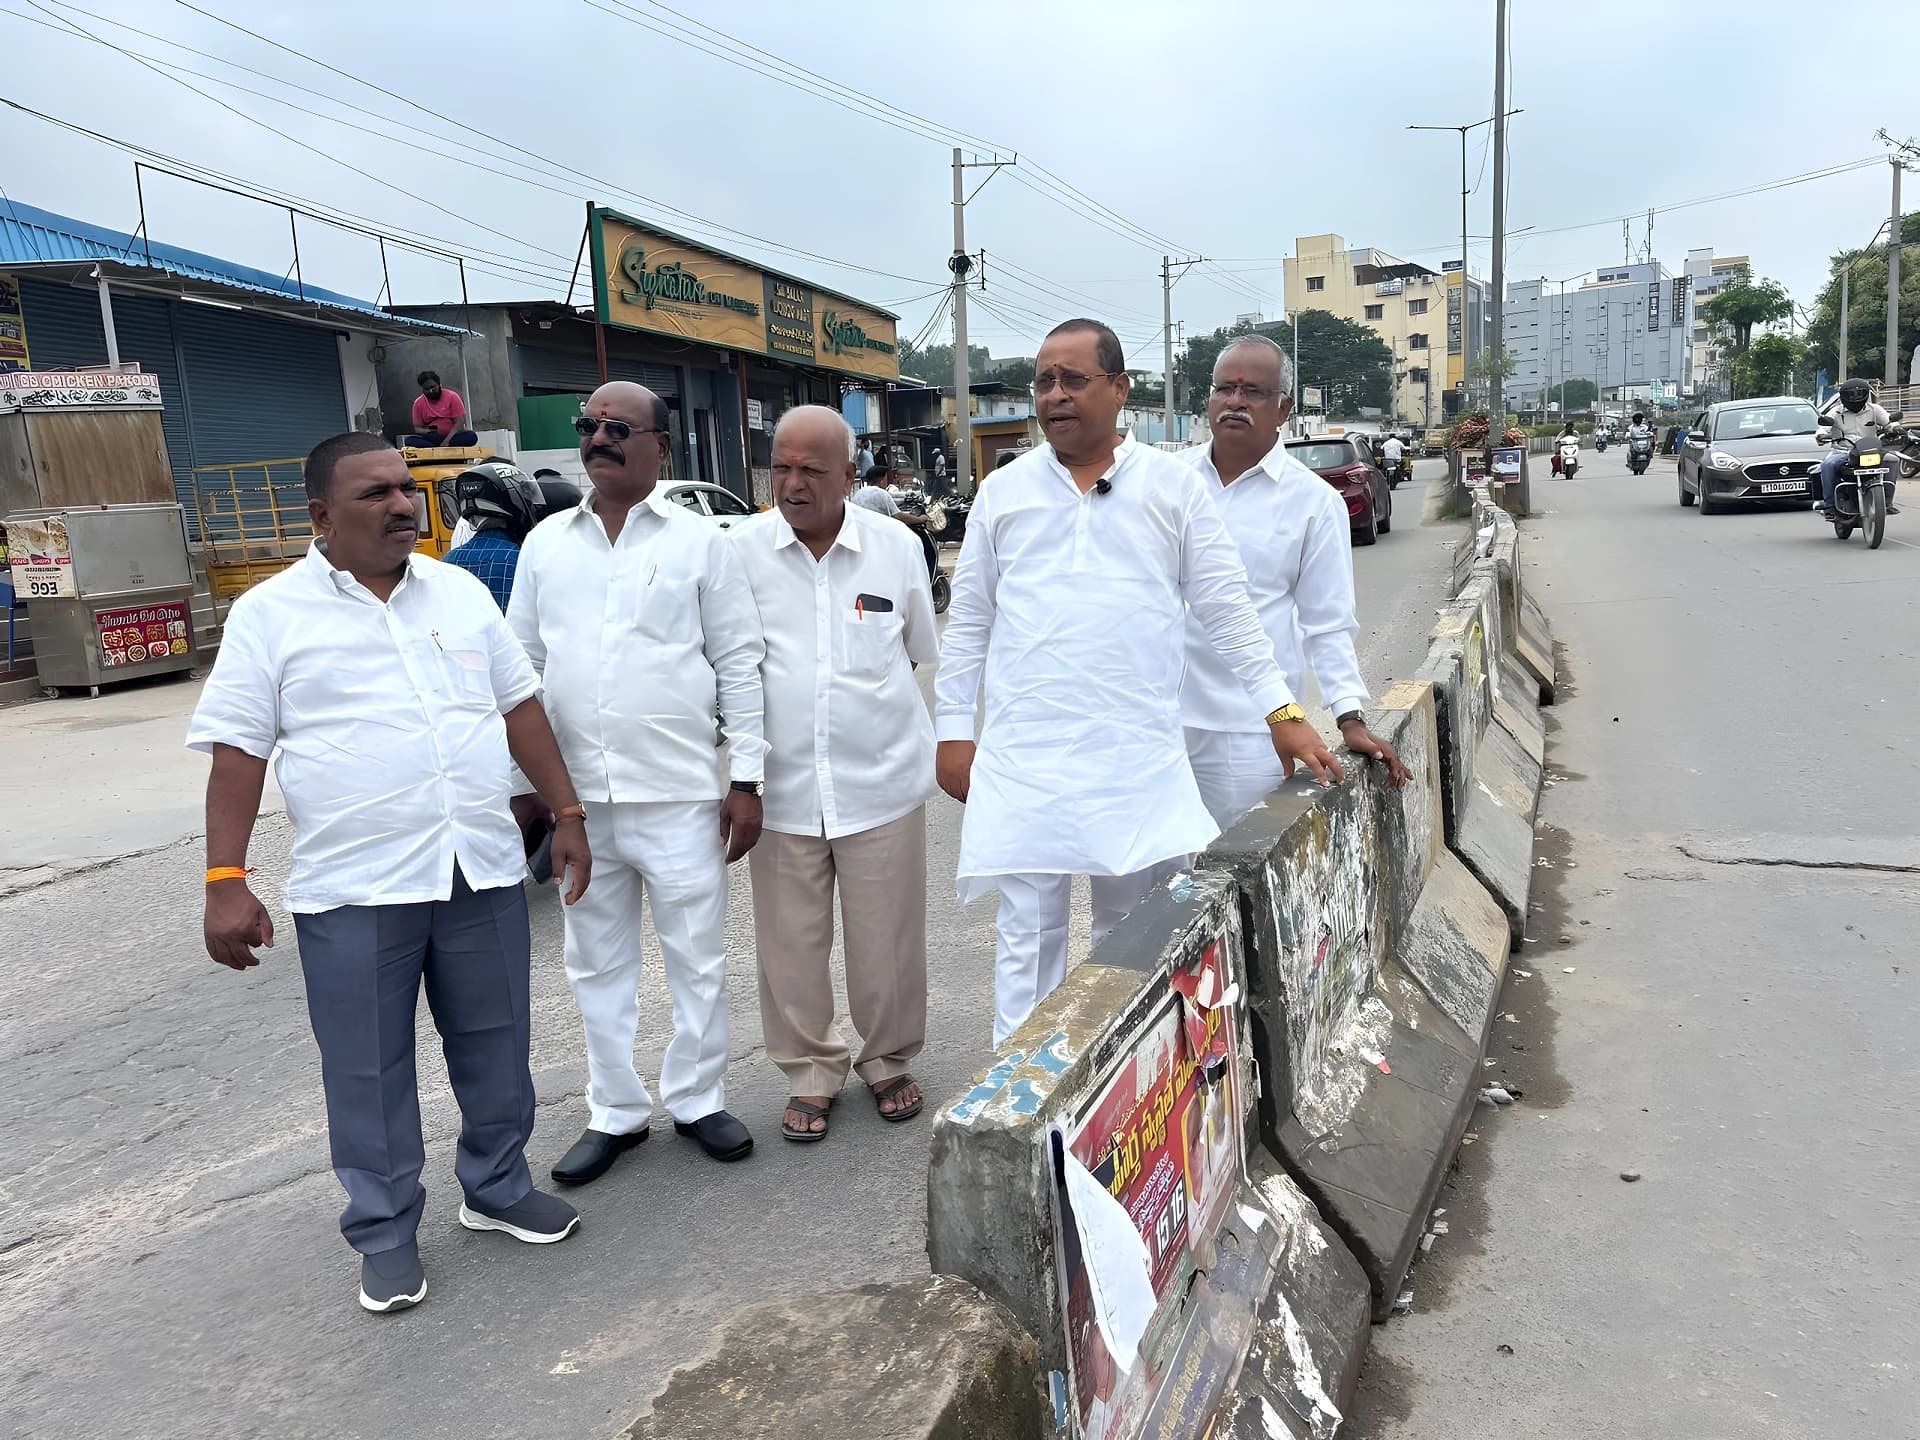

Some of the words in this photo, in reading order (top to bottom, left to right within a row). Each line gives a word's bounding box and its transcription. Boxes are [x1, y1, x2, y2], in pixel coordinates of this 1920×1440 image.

[31, 582, 59, 595] EGG
[1156, 1204, 1170, 1260] 15
[1171, 1178, 1184, 1231] 16
